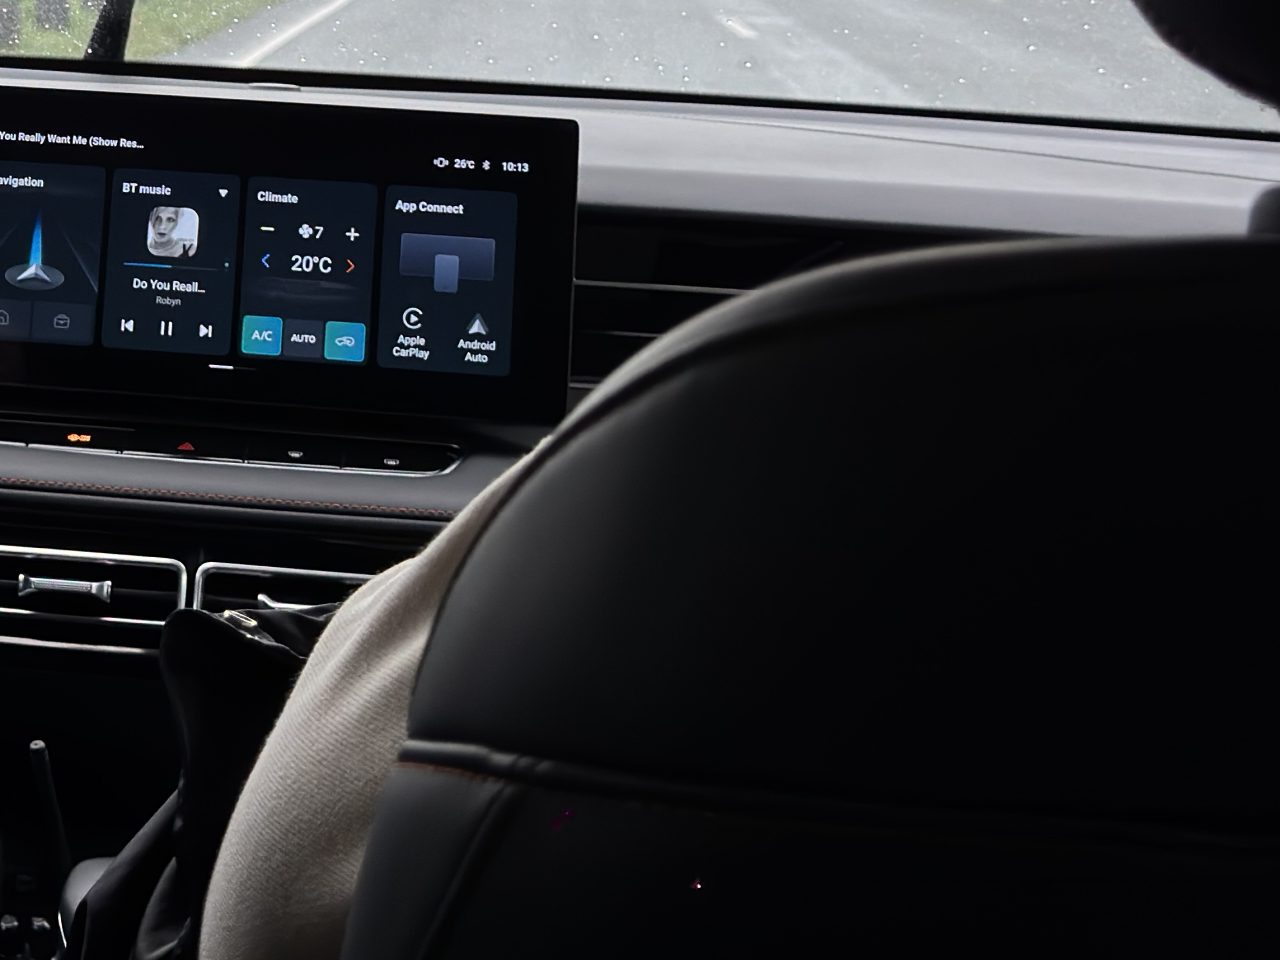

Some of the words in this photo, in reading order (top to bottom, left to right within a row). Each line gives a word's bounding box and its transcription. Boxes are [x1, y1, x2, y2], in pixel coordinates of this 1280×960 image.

[0, 131, 16, 140] You
[18, 132, 45, 144] Really
[48, 134, 70, 144] Want
[73, 136, 87, 145] Me
[89, 136, 118, 147] (Show
[502, 162, 528, 172] 10:13
[123, 183, 138, 193] BT
[139, 185, 171, 195] music
[258, 191, 298, 203] Climate
[395, 200, 417, 213] App
[419, 201, 464, 214] Connect
[315, 226, 323, 238] 7
[291, 255, 332, 273] 20°C
[133, 278, 147, 289] Do
[150, 279, 170, 290] You
[156, 296, 181, 307] Robyn
[252, 330, 272, 341] A/C
[291, 334, 316, 343] AUTO
[397, 335, 425, 347] Apple
[458, 339, 496, 350] Android
[393, 347, 429, 360] CarPlay
[465, 352, 488, 362] Auto
